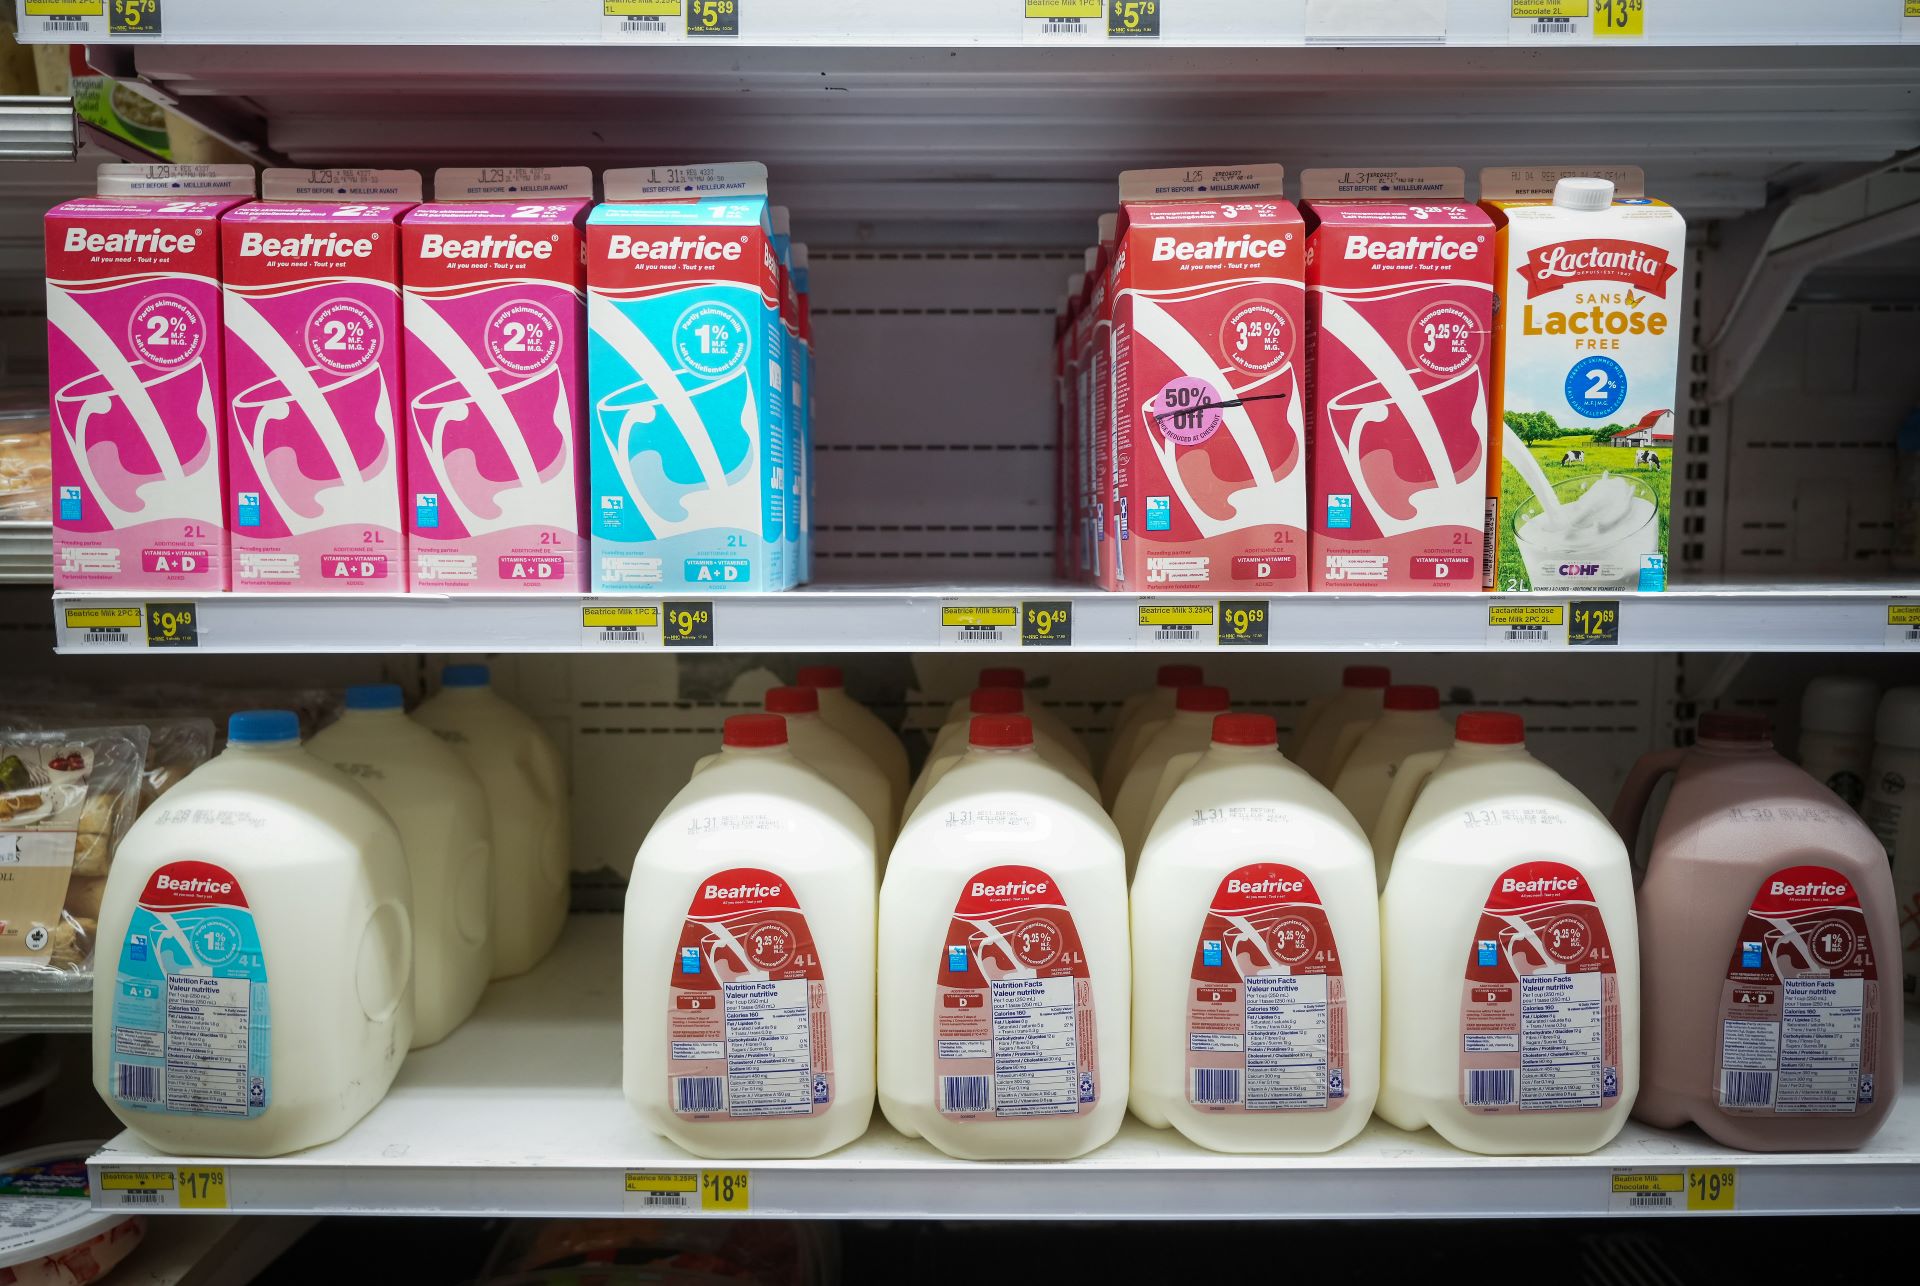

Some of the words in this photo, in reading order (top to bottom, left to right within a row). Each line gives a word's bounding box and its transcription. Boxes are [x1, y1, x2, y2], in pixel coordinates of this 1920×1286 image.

[64, 228, 197, 253] Beatrice
[240, 232, 373, 258] Beatrice
[420, 234, 553, 259] Beatrice
[608, 235, 742, 261] Beatrice
[1152, 235, 1286, 261] Beatrice
[1344, 235, 1478, 261] Beatrice
[1538, 247, 1658, 280] Lactantia
[1576, 294, 1621, 304] SANS
[1523, 305, 1668, 336] Lactose
[1576, 339, 1620, 350] FREE
[1166, 387, 1211, 407] 50%
[1167, 430, 1191, 442] REDUCED
[1200, 414, 1220, 439] CHECKOUT
[1258, 564, 1271, 578] D
[1435, 564, 1449, 578] D
[1559, 564, 1600, 576] CDHF
[157, 875, 232, 894] Beatrice
[705, 883, 781, 899] Beatrice
[972, 881, 1047, 897] Beatrice
[1228, 879, 1303, 893] Beatrice
[1502, 877, 1578, 893] Beatrice
[1771, 882, 1846, 896] Beatrice
[993, 981, 1023, 989] Nutrition
[993, 989, 1016, 997] Valeur
[1017, 988, 1045, 996] nutritive
[726, 991, 749, 999] Valeur
